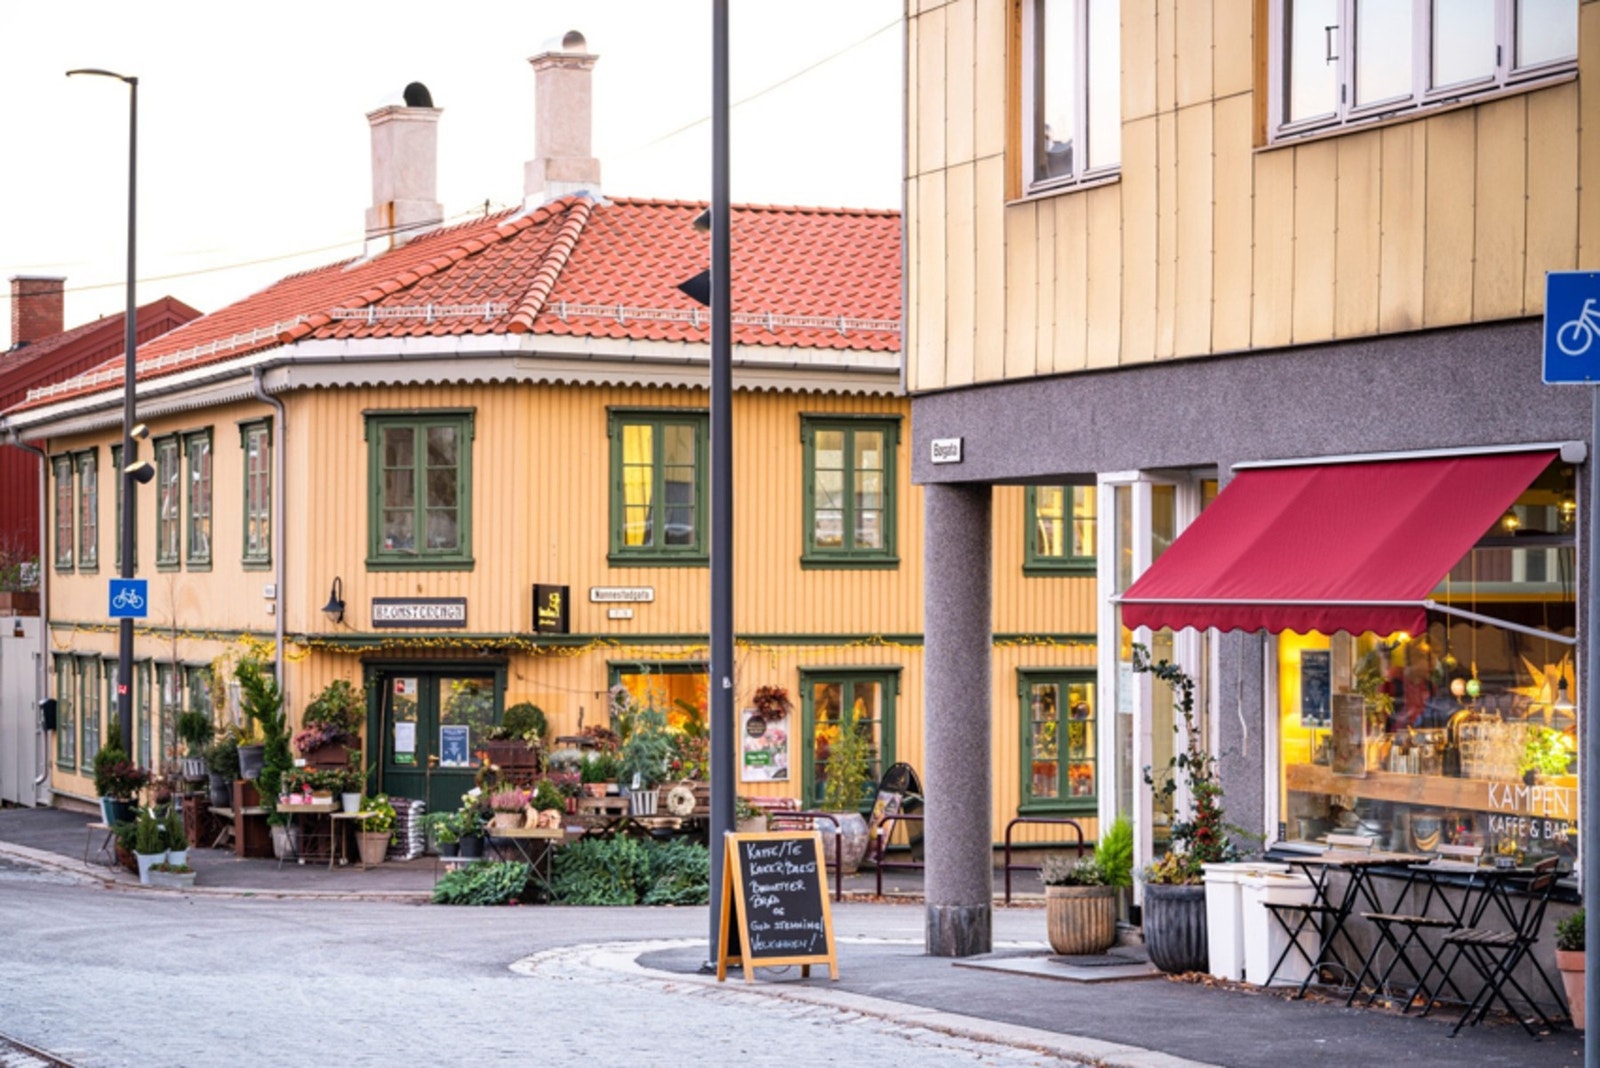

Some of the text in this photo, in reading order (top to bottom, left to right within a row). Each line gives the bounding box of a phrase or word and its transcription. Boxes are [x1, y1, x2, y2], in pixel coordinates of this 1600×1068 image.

[1488, 781, 1570, 816] KAMPEN
[1488, 815, 1570, 841] KAFFE & BAR
